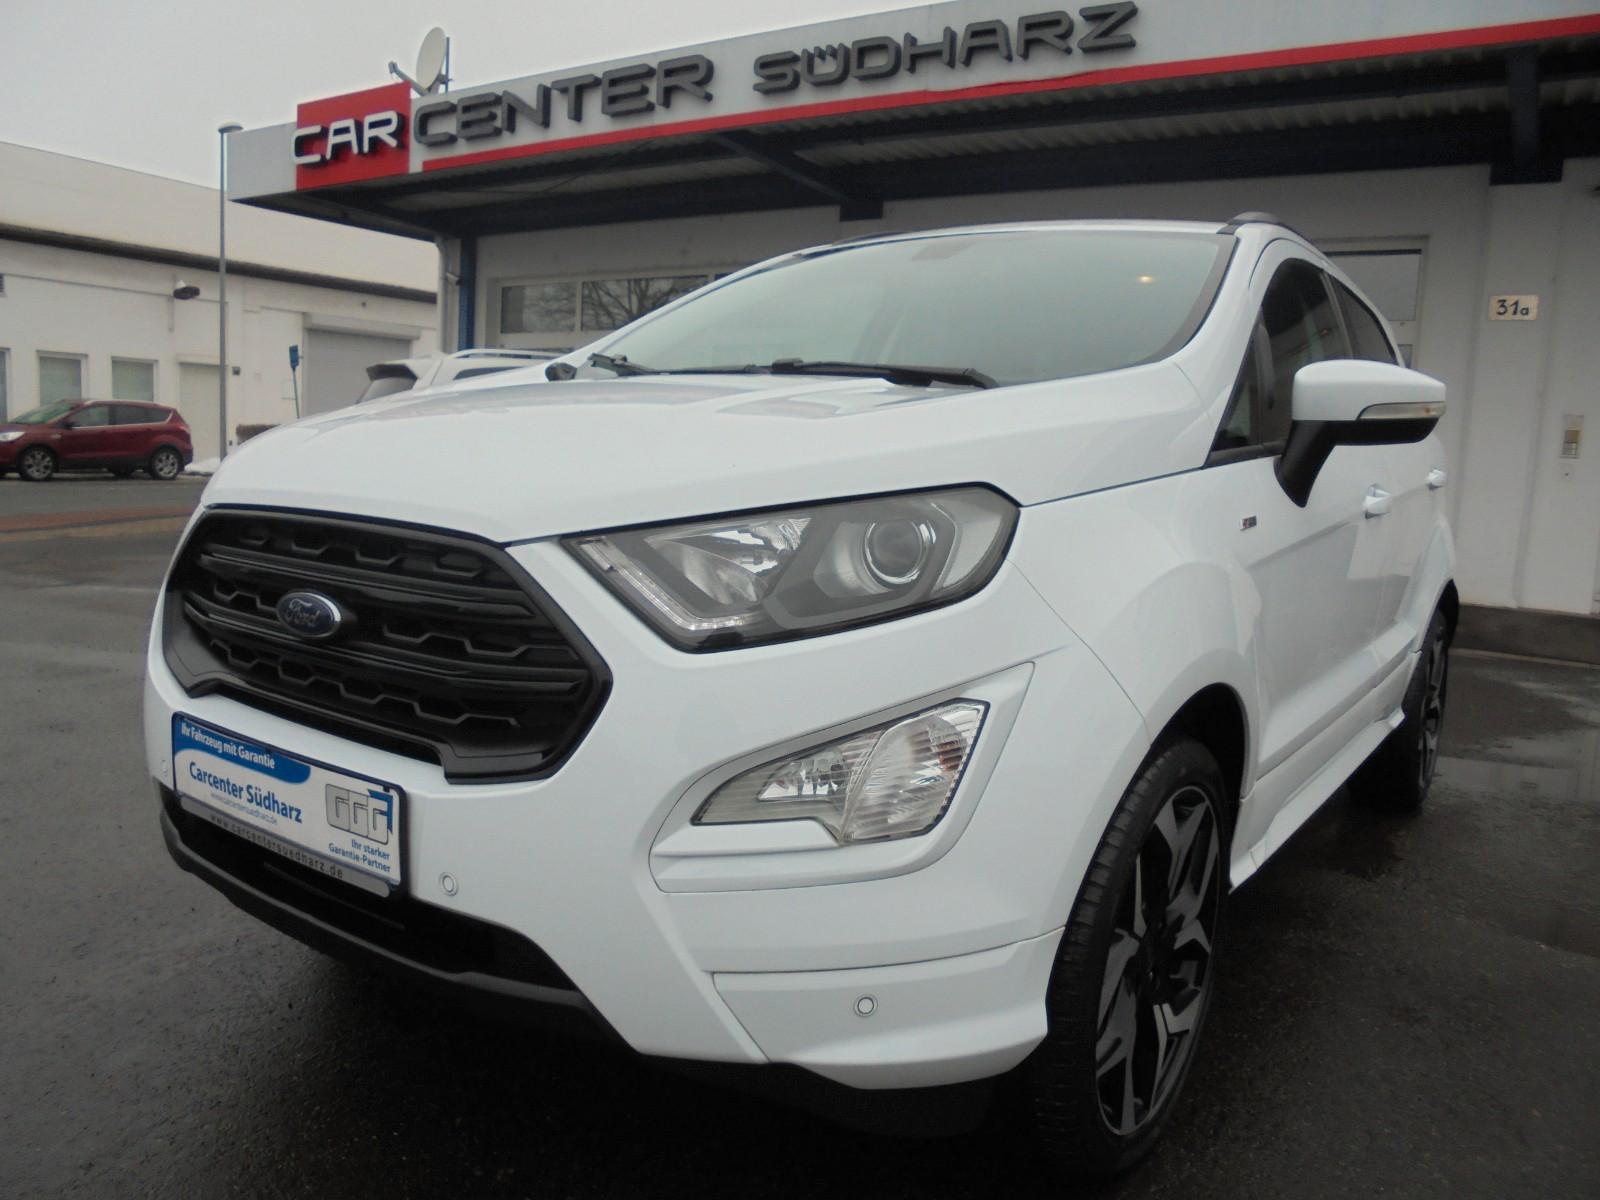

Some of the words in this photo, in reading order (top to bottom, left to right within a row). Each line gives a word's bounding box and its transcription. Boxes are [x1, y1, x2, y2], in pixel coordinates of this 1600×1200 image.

[291, 110, 402, 166] CAR
[414, 53, 714, 148] CENTER
[753, 1, 1138, 95] SÜDHARZ
[1496, 298, 1530, 316] 31a
[180, 722, 191, 737] Ihr
[191, 726, 223, 754] Fahrzeug
[223, 742, 238, 756] mit
[238, 745, 275, 769] Garantie
[189, 761, 243, 800] Carcenter
[246, 784, 303, 824] Südharz
[328, 842, 391, 873] Garantie-Partner
[351, 839, 362, 850] Ihr
[363, 845, 391, 860] starker
